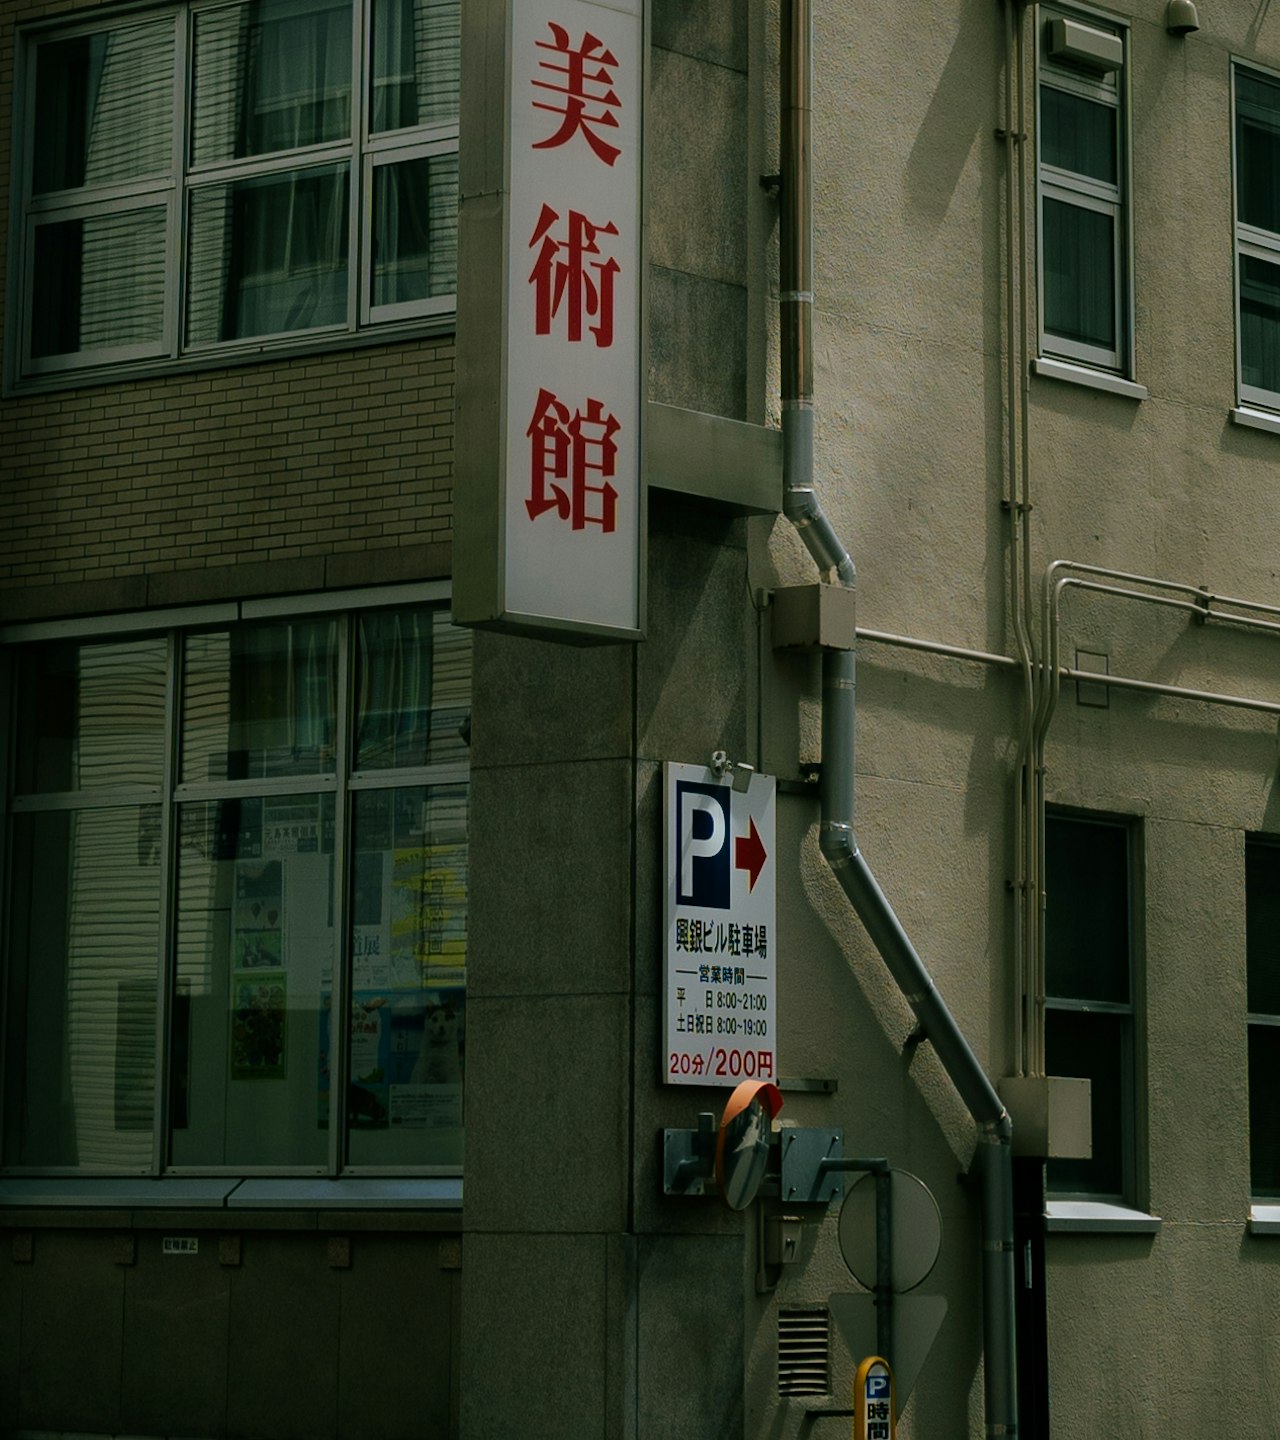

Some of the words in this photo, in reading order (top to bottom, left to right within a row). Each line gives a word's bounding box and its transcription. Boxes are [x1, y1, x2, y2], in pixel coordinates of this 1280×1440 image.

[681, 791, 726, 898] P
[676, 918, 768, 960] 興銀ビル駐車場
[699, 964, 745, 986] 営業時間
[676, 1013, 713, 1035] 土日祝日
[670, 1046, 773, 1079] 20分/200円
[869, 1377, 887, 1396] P
